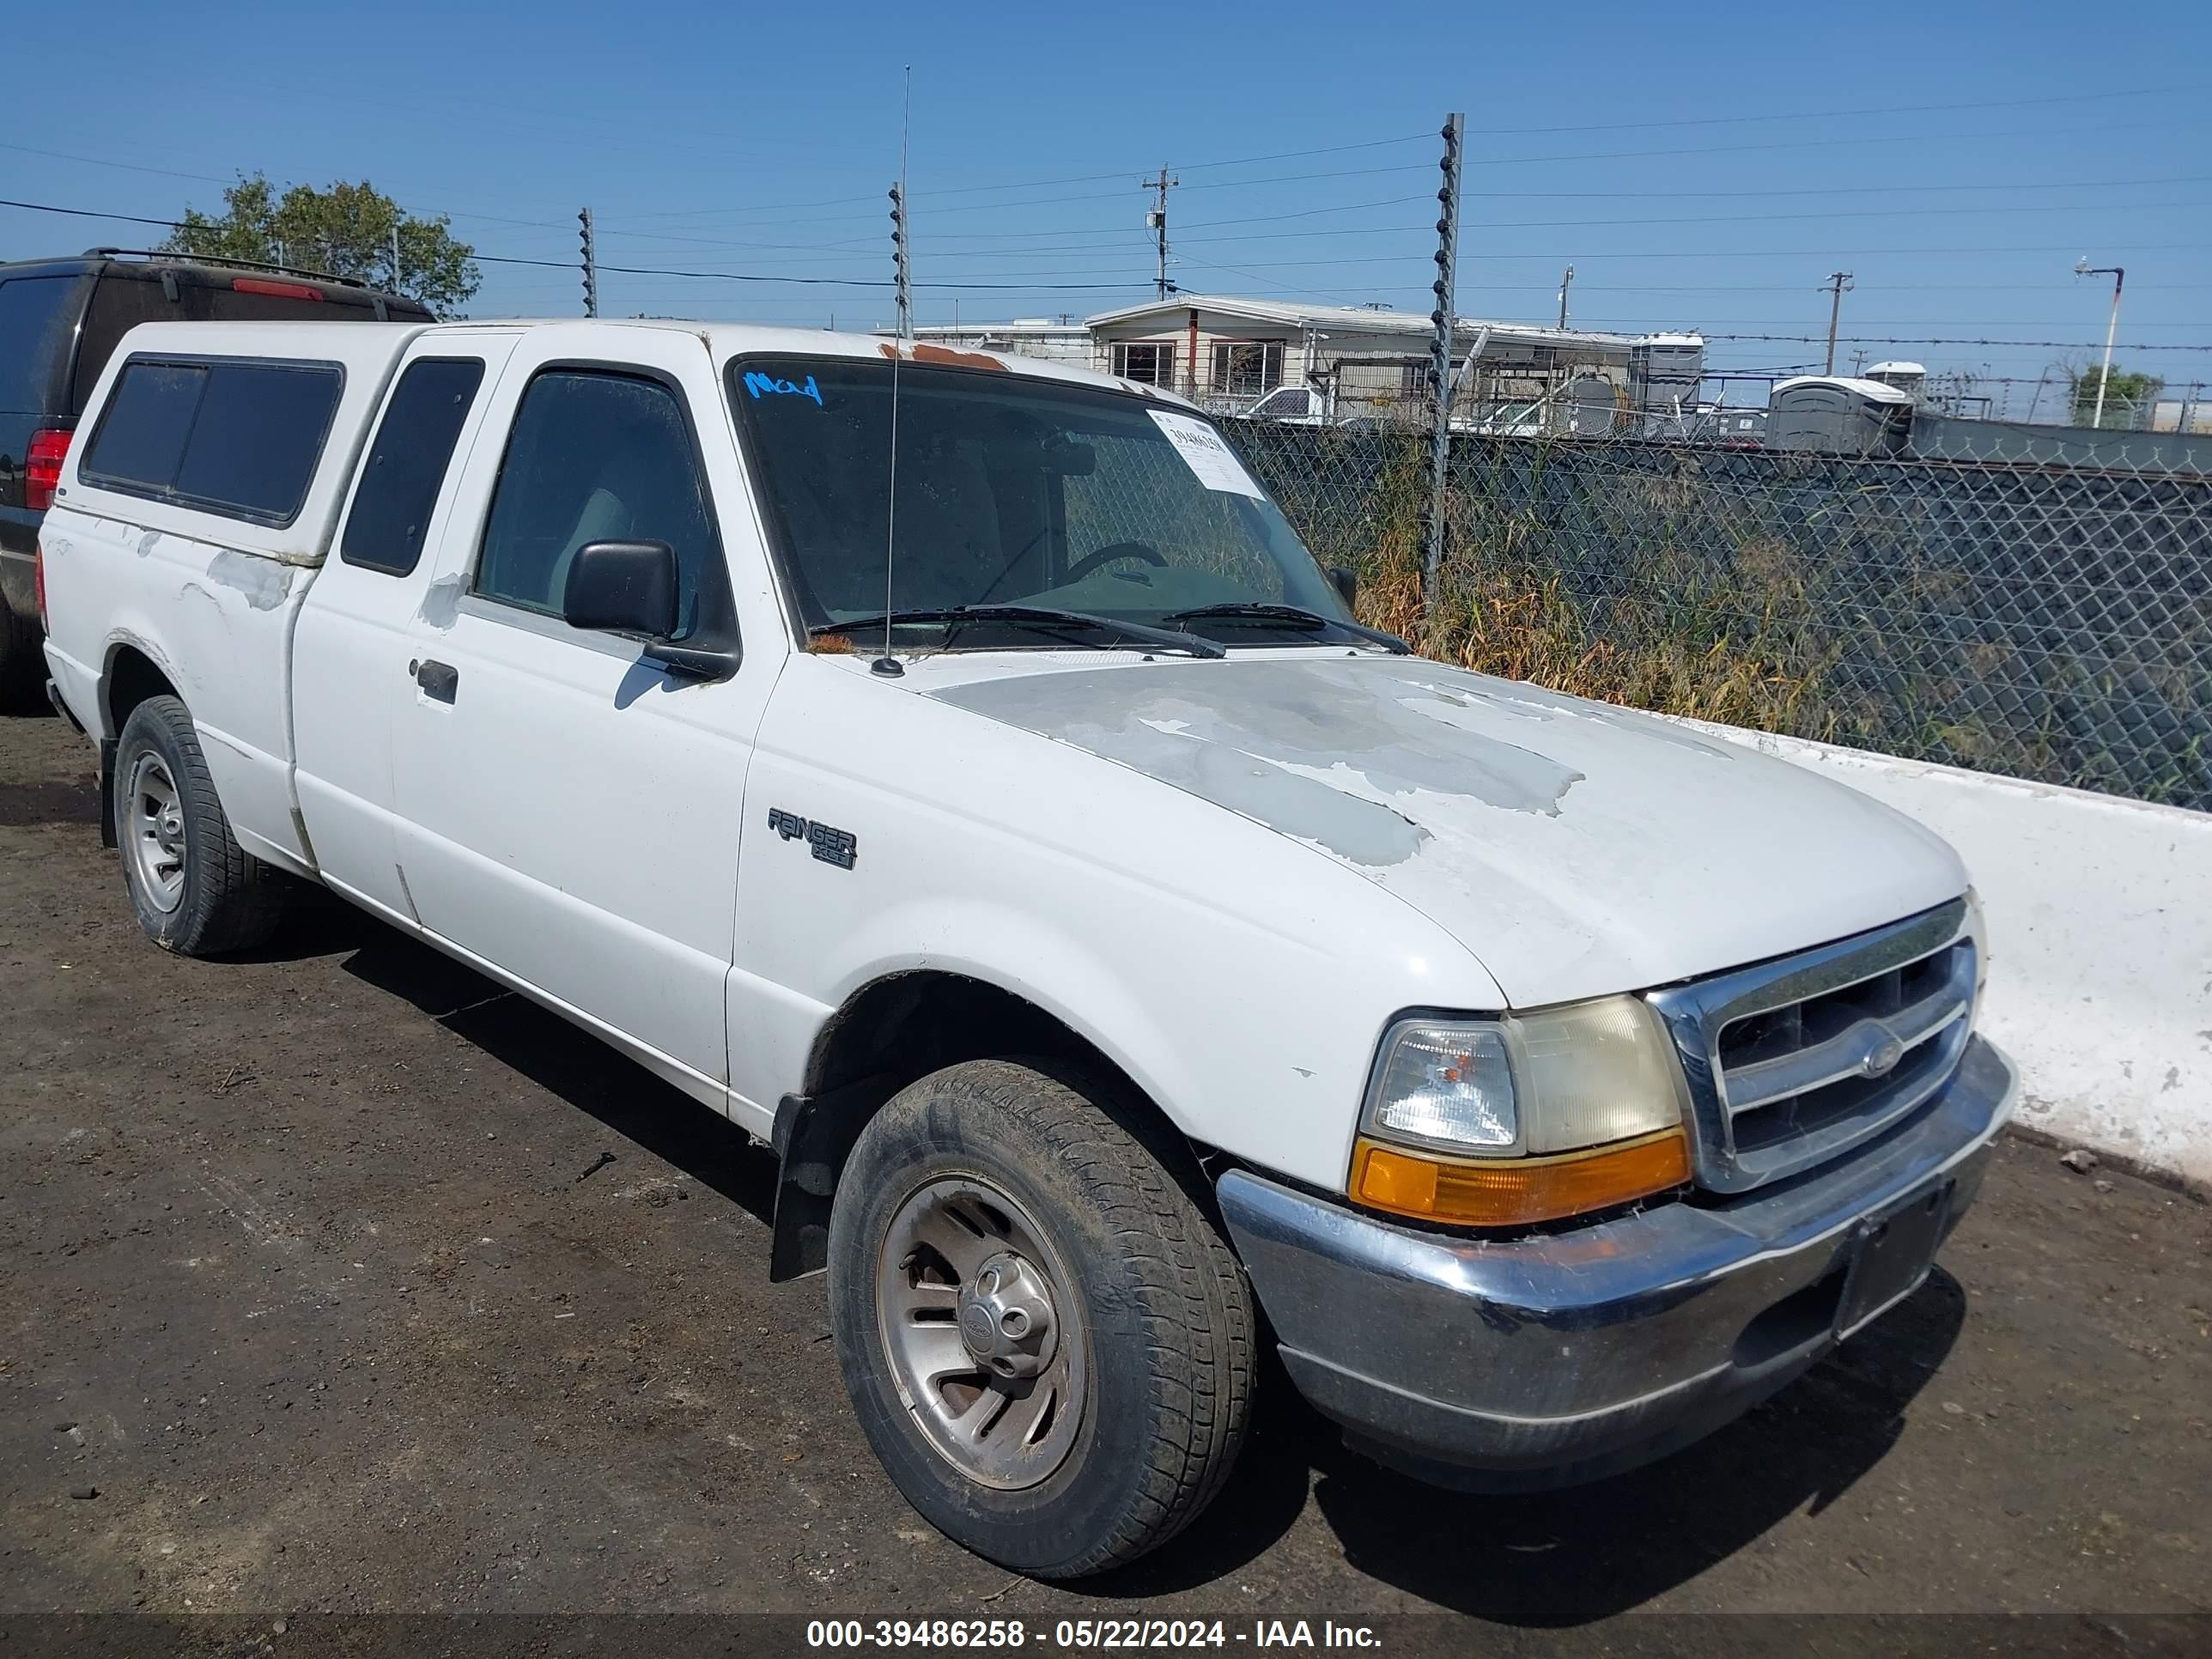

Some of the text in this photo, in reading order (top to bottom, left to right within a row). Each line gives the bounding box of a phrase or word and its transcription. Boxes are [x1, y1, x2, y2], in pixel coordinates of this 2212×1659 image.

[1170, 429, 1226, 454] 39486258
[768, 807, 858, 858] RANGER
[813, 844, 852, 868] XLT
